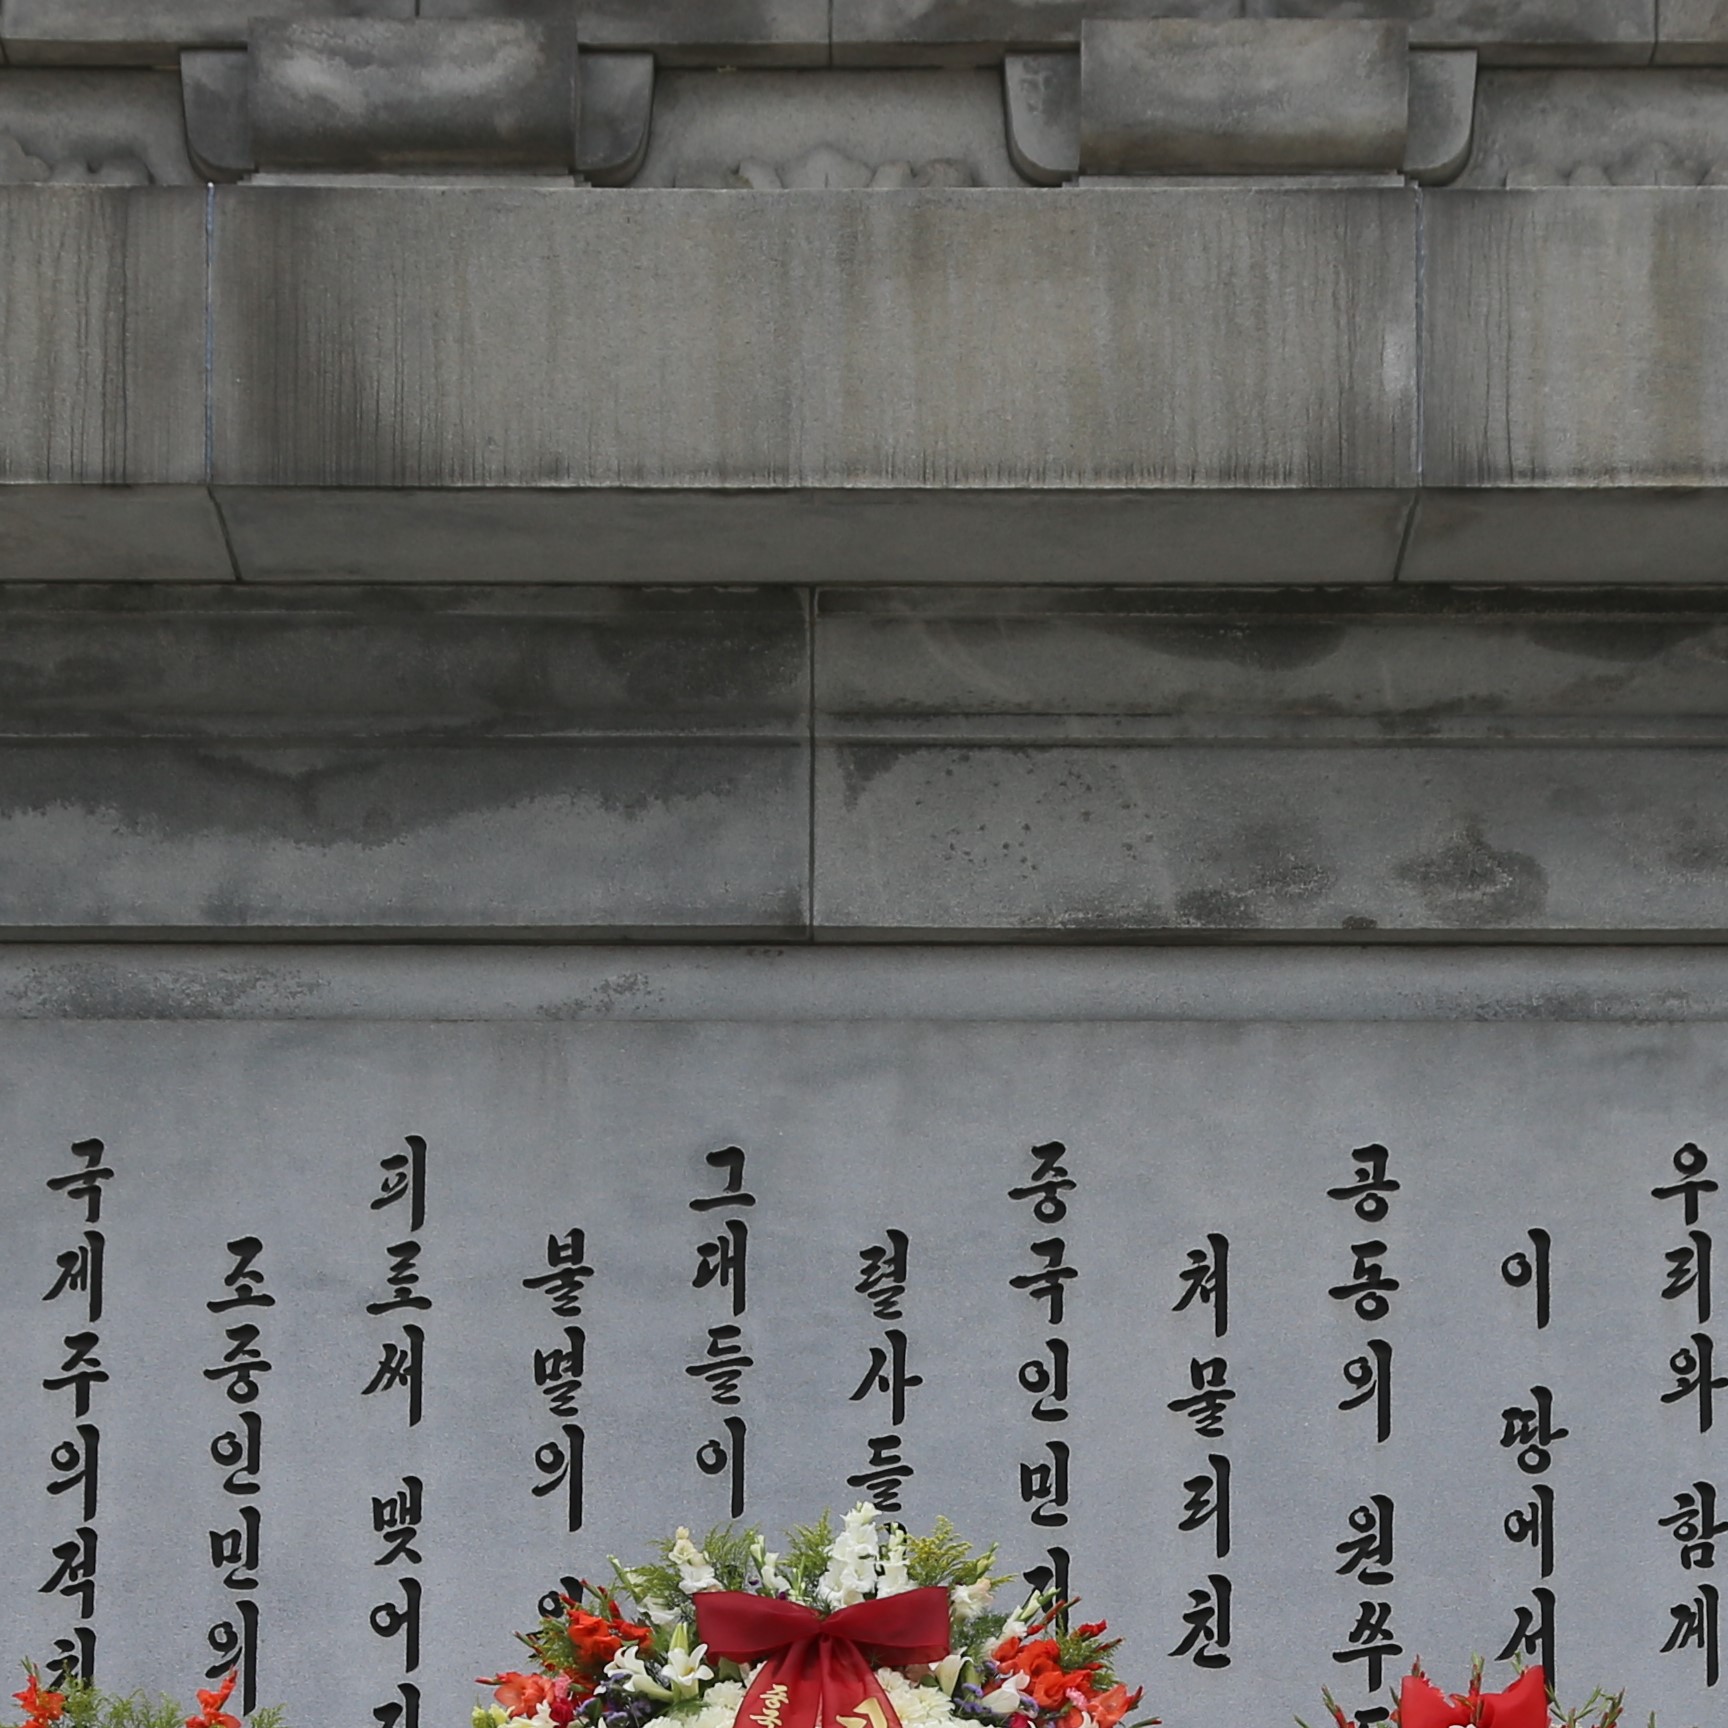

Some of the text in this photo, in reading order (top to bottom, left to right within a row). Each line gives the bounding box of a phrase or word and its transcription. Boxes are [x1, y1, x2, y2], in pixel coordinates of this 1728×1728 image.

[362, 1135, 432, 1427] 피로써
[522, 1227, 594, 1533] 불멸의
[685, 1146, 756, 1519] 그대들이
[1327, 1143, 1400, 1443] 공동의
[203, 1236, 276, 1716] 조중인민의
[1496, 1228, 1569, 1695] 이 땅에서
